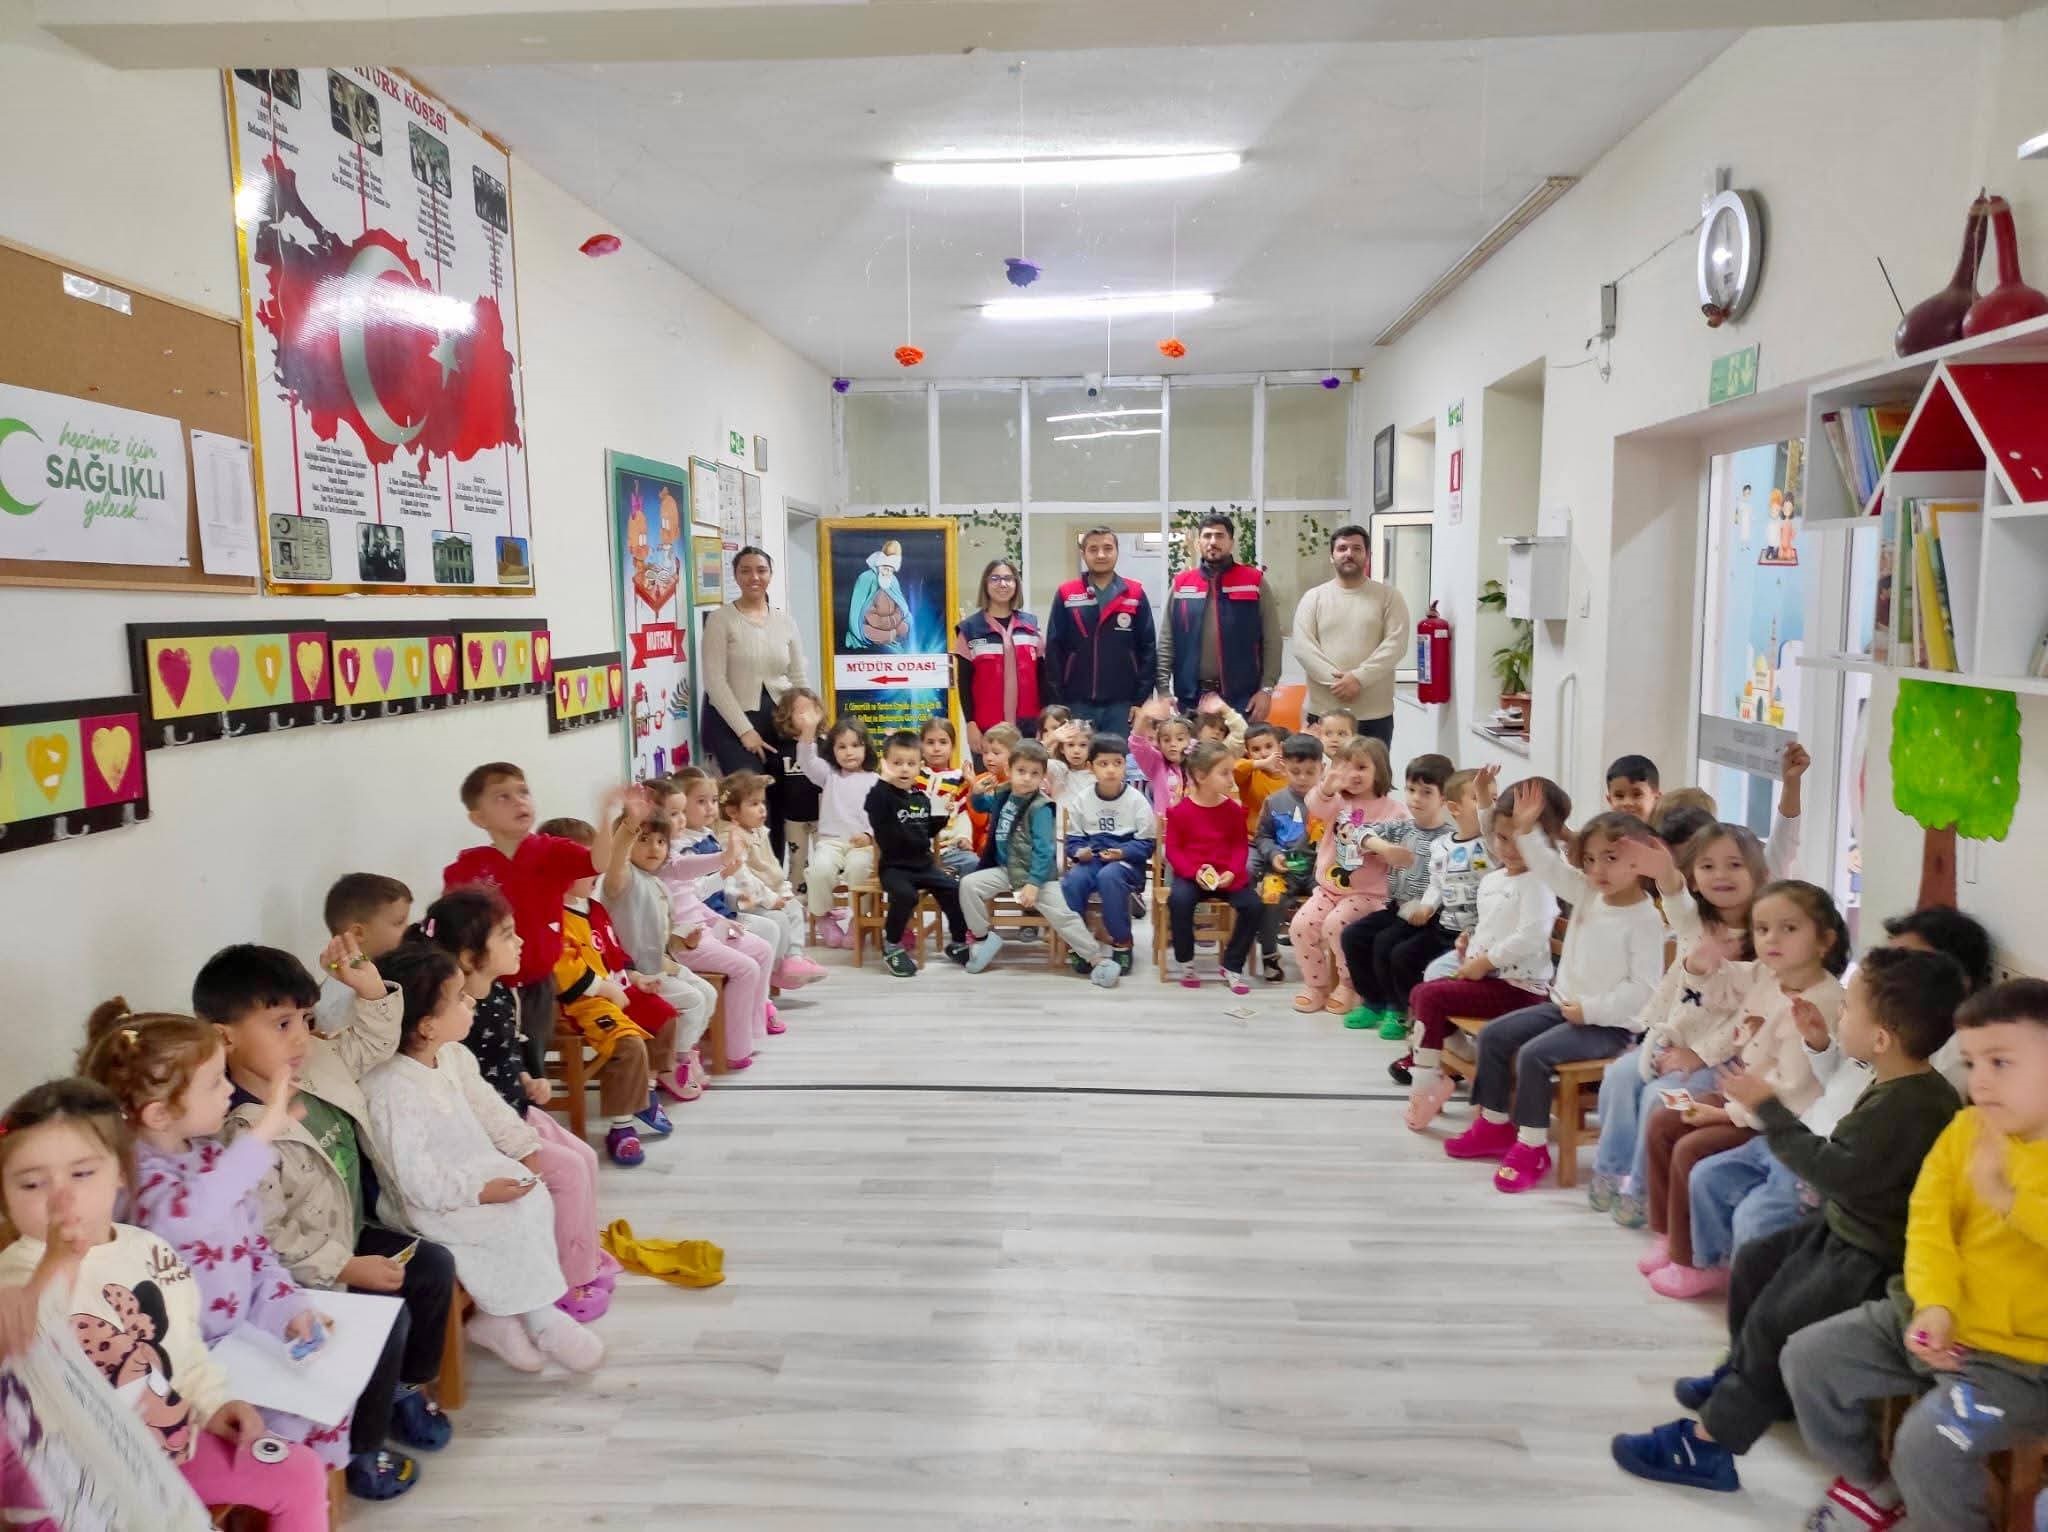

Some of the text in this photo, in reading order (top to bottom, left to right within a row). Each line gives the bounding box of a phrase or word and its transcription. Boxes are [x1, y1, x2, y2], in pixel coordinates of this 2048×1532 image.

[404, 89, 448, 135] KÖŞESİ
[59, 422, 157, 465] hepimiz için
[46, 453, 165, 500] SAĞLIKLI
[846, 661, 937, 672] MÜDÜR ODASI
[1098, 817, 1115, 832] 89
